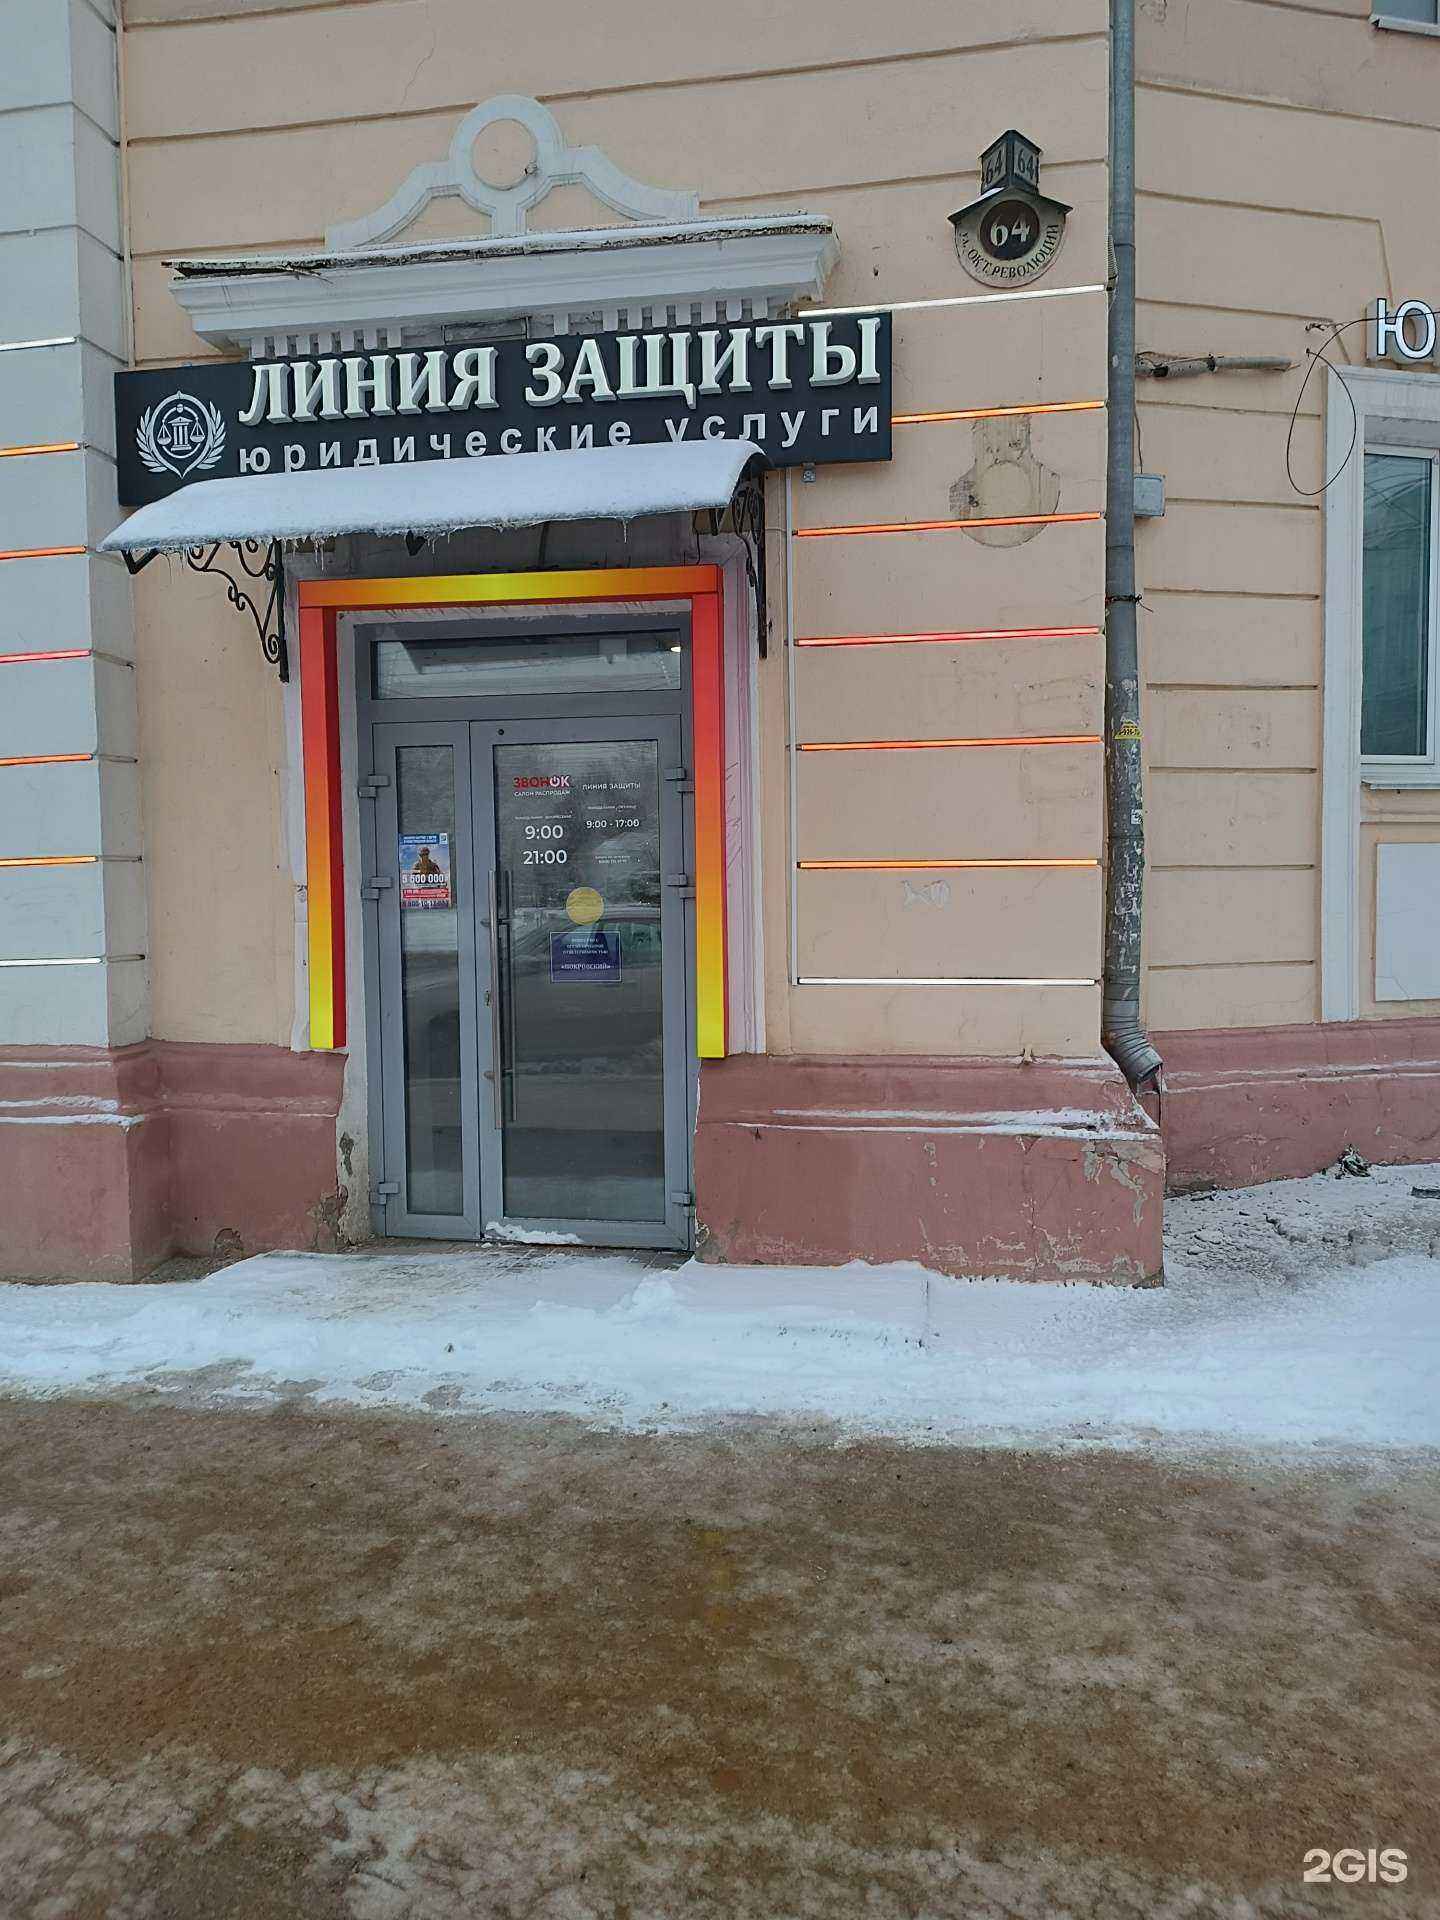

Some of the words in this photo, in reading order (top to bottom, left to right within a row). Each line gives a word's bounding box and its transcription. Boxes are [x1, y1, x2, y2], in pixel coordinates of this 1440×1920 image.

[1018, 149, 1034, 180] 64
[990, 215, 1031, 247] 64
[238, 347, 499, 426] ЛИНИЯ
[525, 318, 881, 409] ЗАЩИТЫ
[239, 420, 631, 473] юридические
[664, 406, 878, 448] услуги
[513, 775, 570, 788] ЗВОНОК
[609, 782, 640, 790] ЗАЩИТЫ
[586, 820, 607, 829] 9:00
[615, 819, 640, 828] 17:00
[525, 825, 564, 840] 9:00
[522, 849, 568, 865] 21:00
